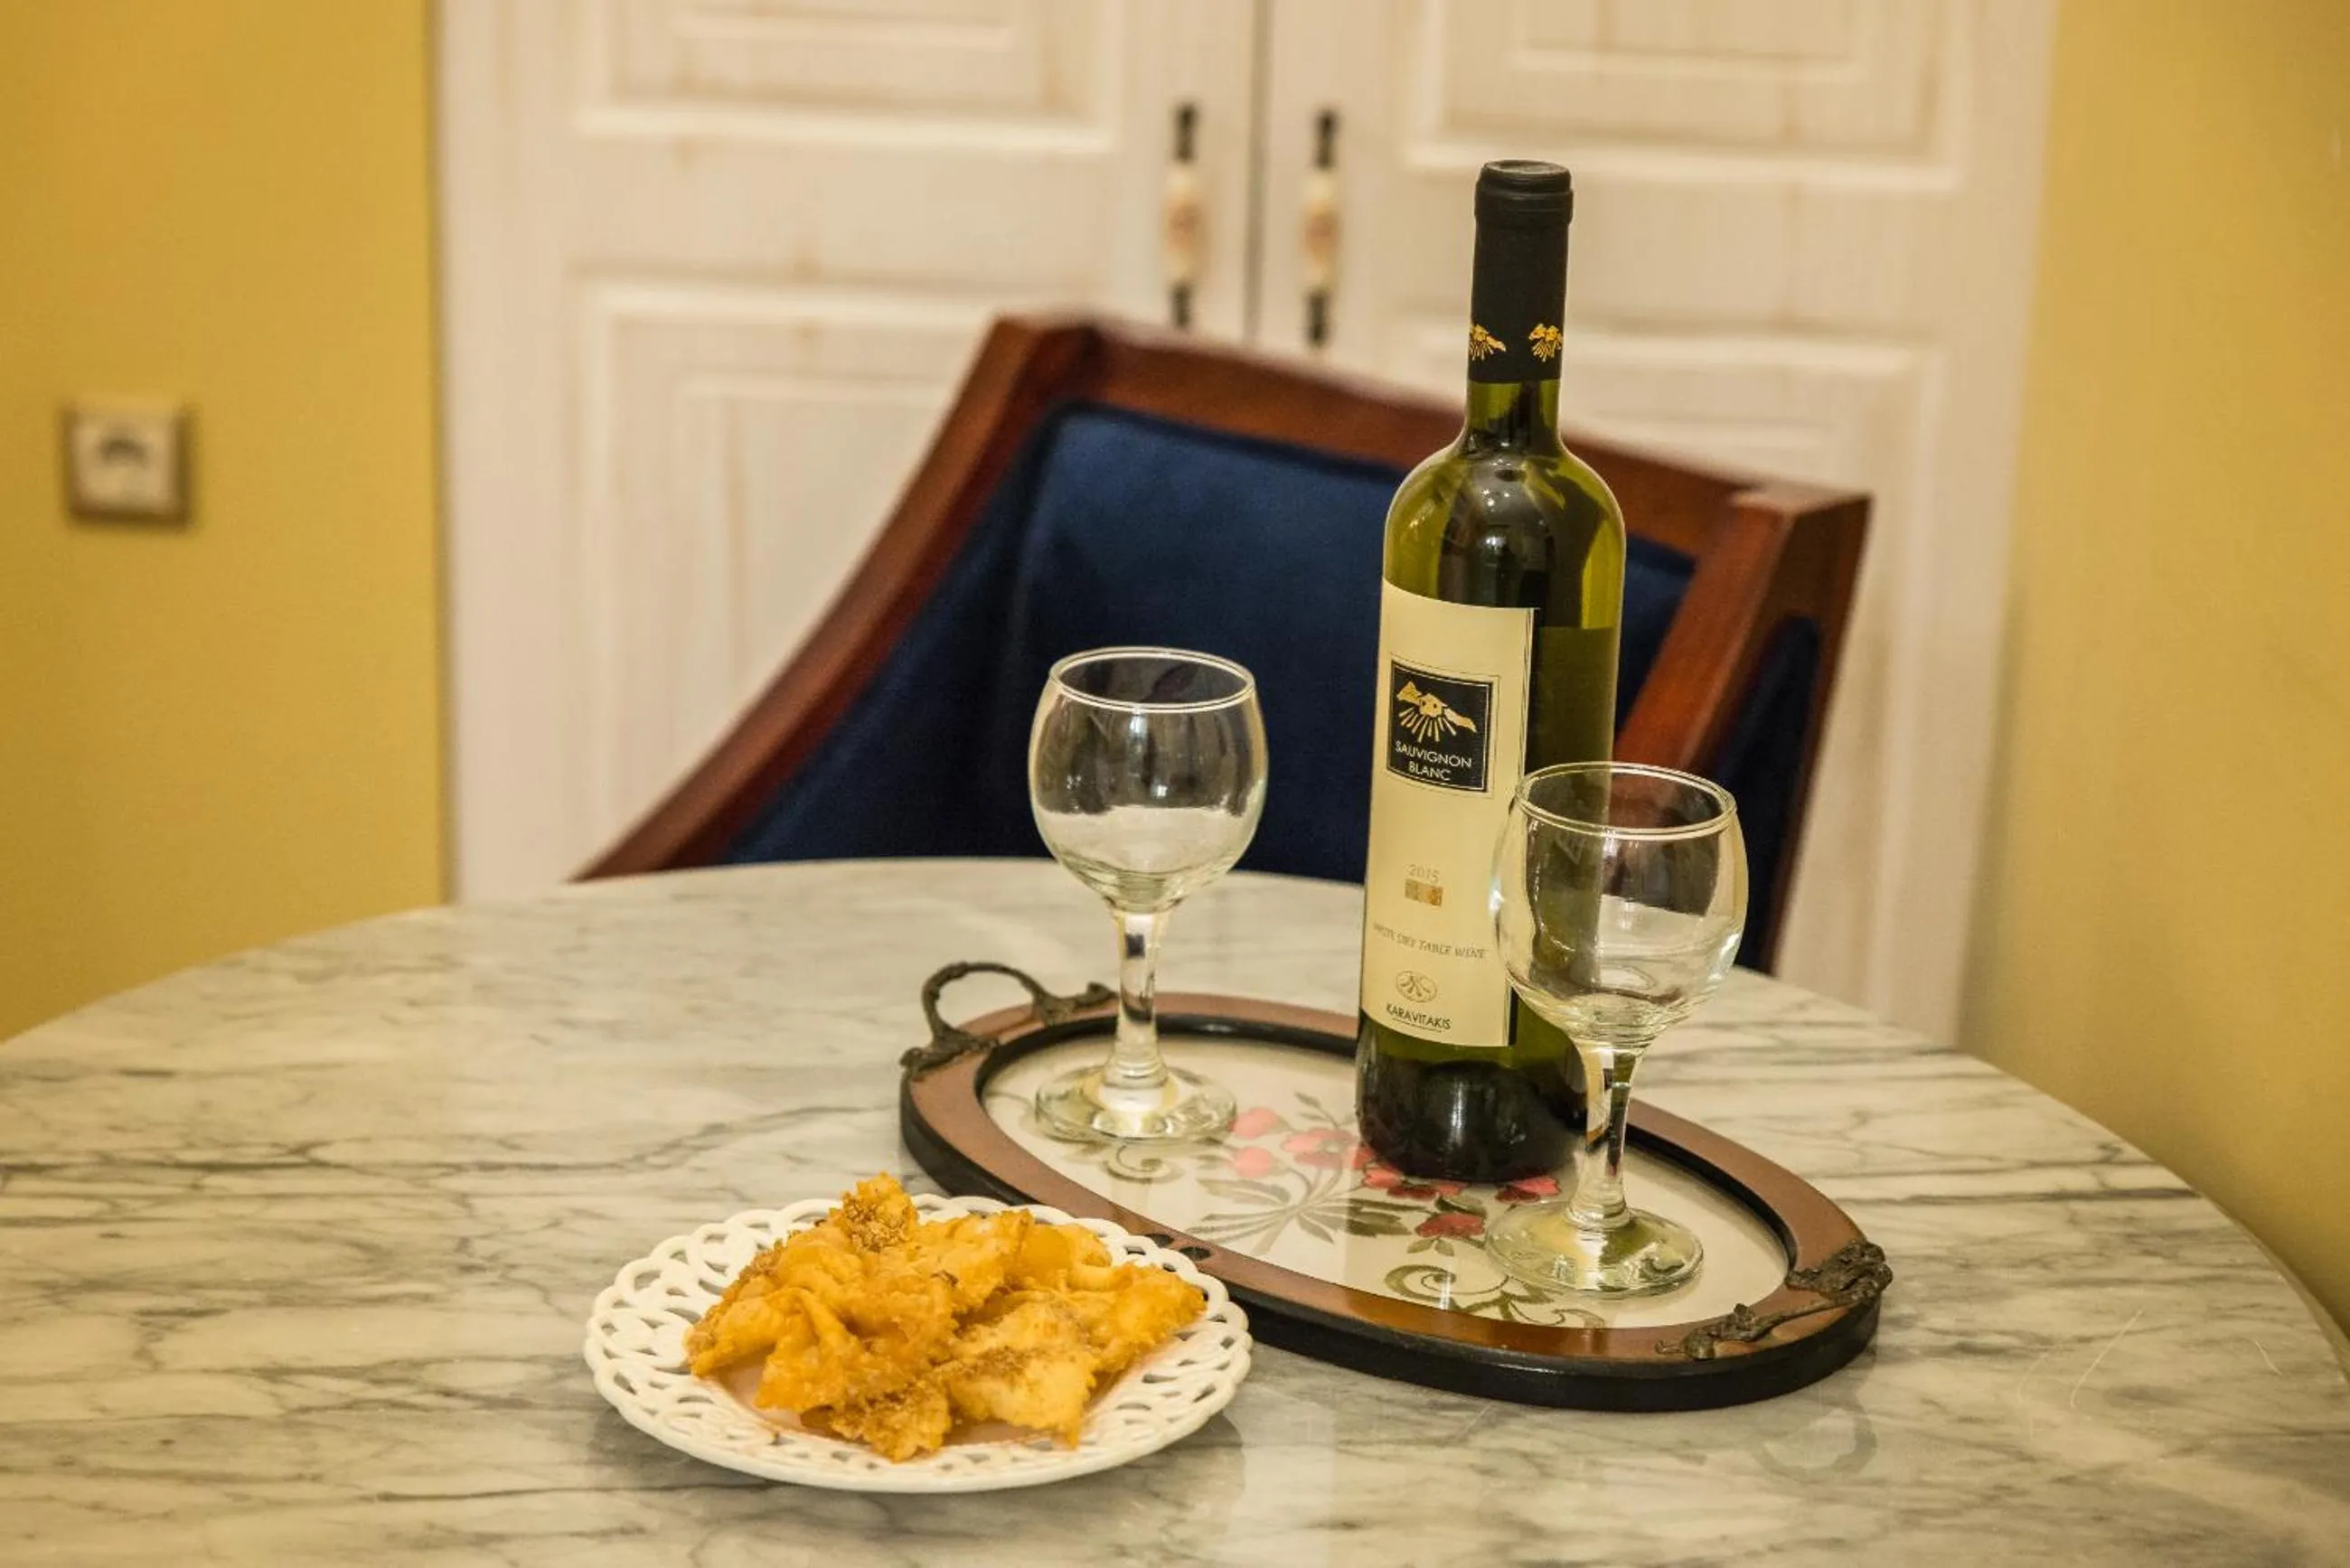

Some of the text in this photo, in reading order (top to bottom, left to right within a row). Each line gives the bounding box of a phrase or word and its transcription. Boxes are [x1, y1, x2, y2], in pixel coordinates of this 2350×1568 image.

[1395, 740, 1472, 767] SAUVIGNON
[1408, 761, 1451, 781] BLANC
[1408, 865, 1439, 883] 2015
[1418, 940, 1452, 956] TABLE
[1455, 947, 1486, 959] WINE
[1386, 1003, 1452, 1030] KARAVITAKIS
